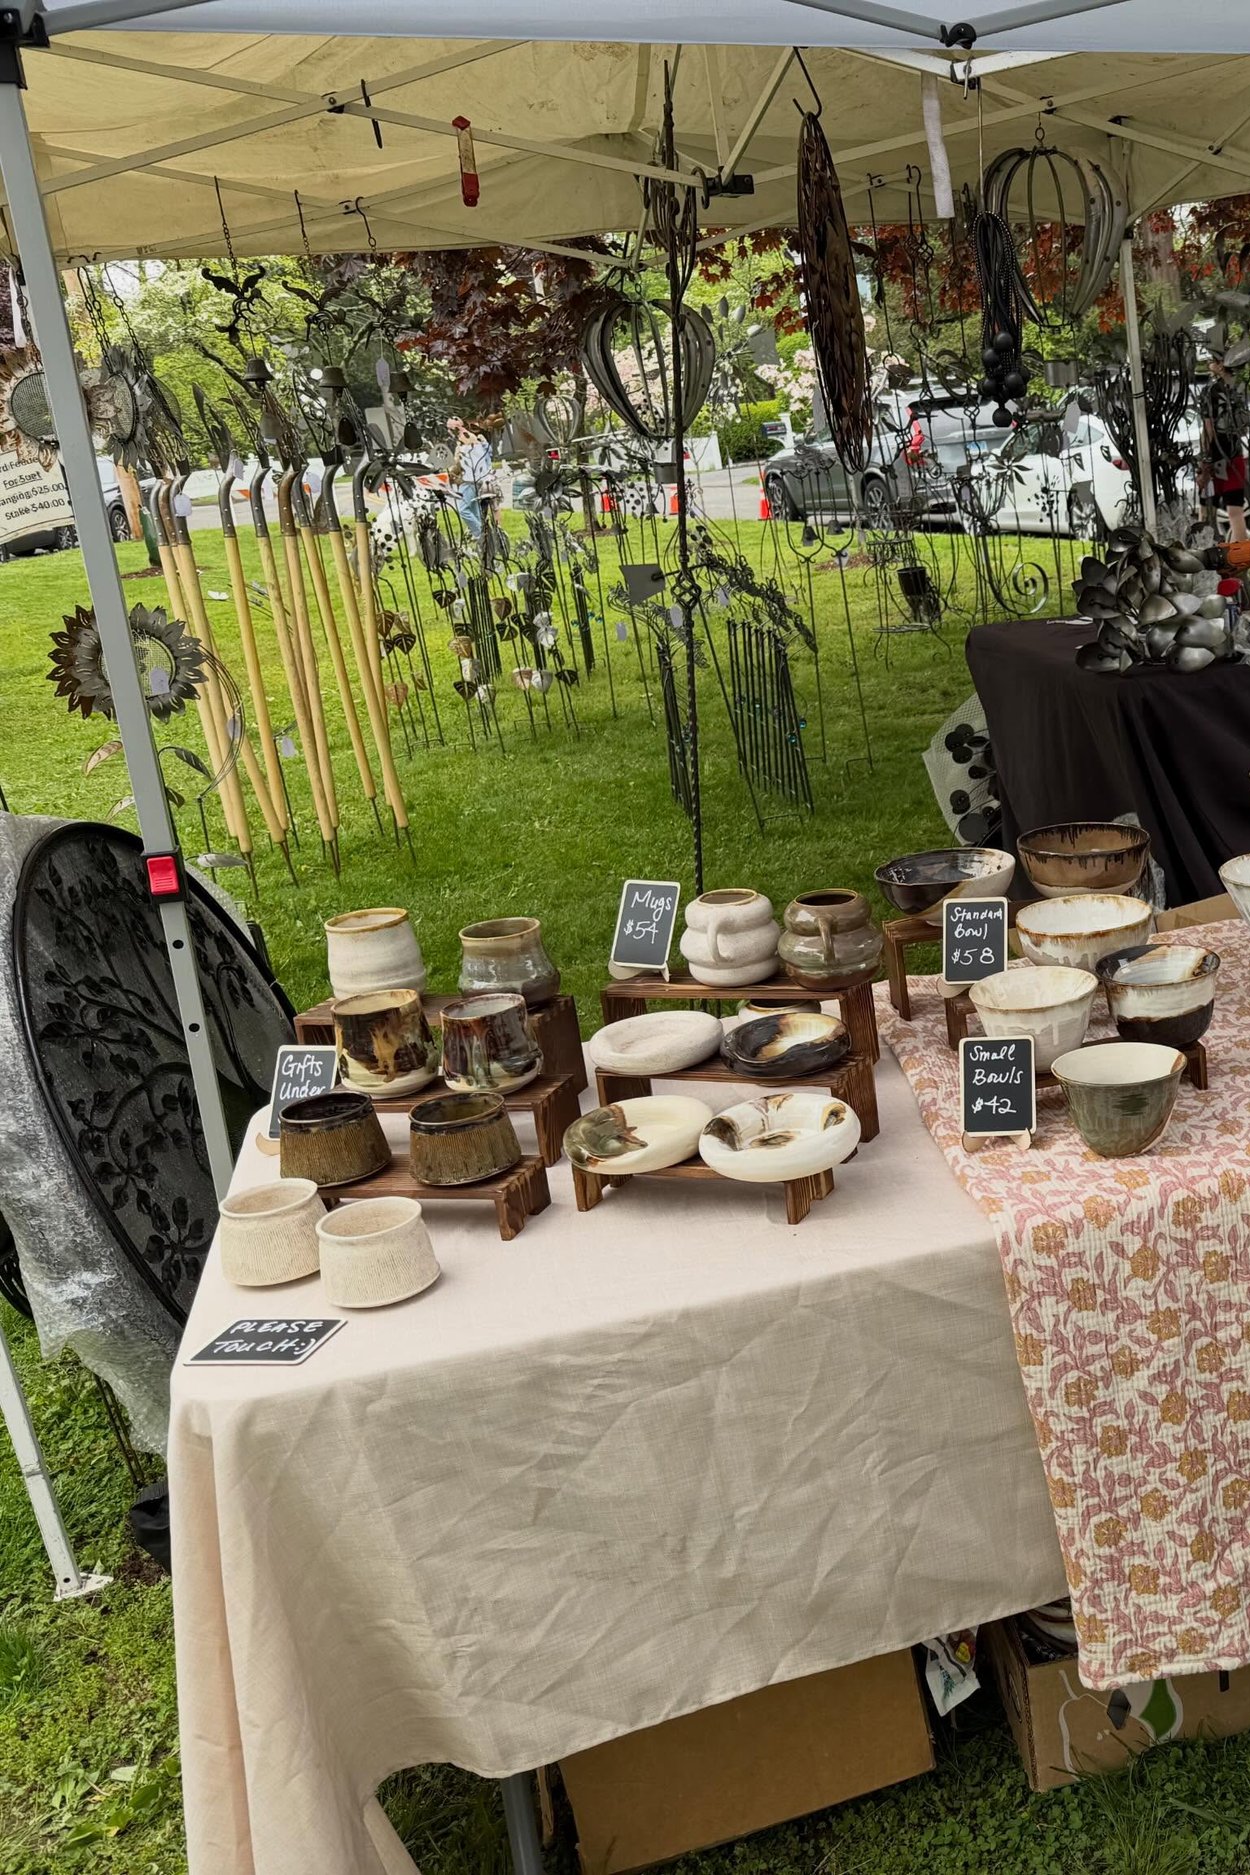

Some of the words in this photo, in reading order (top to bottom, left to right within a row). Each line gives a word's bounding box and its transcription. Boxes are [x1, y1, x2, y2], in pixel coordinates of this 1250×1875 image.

[0, 491, 32, 506] anging
[31, 482, 65, 496] $25.00
[5, 507, 30, 520] Stake
[31, 498, 65, 512] $40.00
[631, 889, 672, 922] Mugs
[950, 906, 1003, 922] Standard
[623, 919, 658, 944] $54
[954, 923, 987, 940] Bowl
[951, 947, 995, 965] $58
[969, 1043, 1016, 1061] Small
[281, 1054, 323, 1082] Gifts
[972, 1066, 1023, 1085] Bowls
[279, 1080, 326, 1100] Under
[971, 1095, 1017, 1114] $42
[229, 1320, 324, 1334] PLEASE
